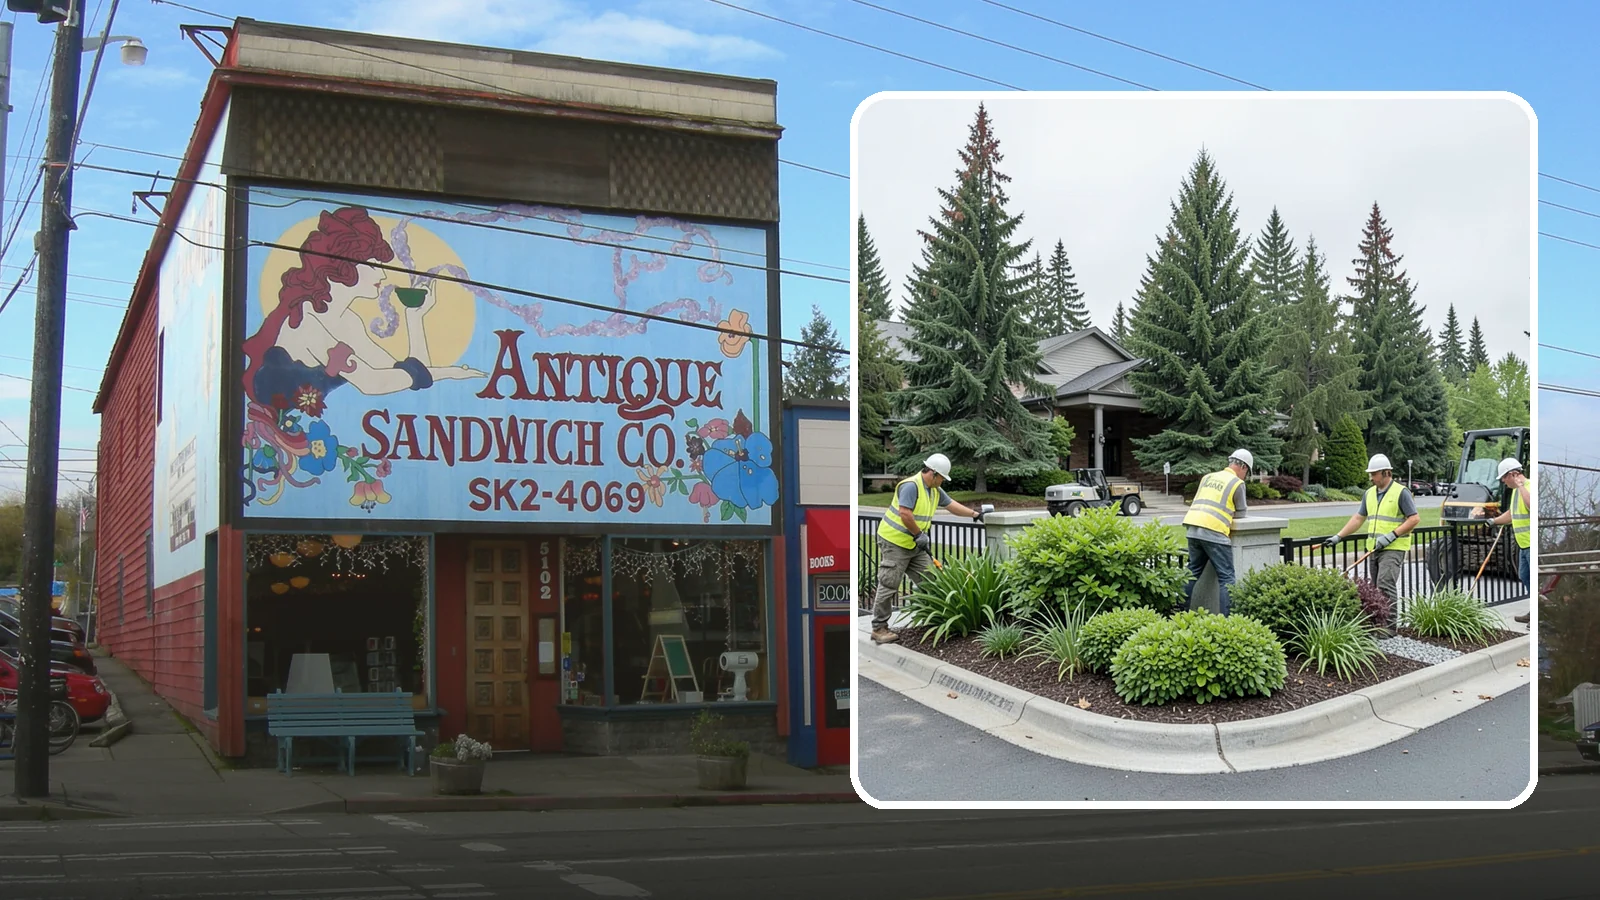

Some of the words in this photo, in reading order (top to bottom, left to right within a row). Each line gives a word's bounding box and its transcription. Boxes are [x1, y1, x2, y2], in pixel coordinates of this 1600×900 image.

[476, 329, 723, 421] ANTIQUE
[360, 408, 605, 467] SANDWICH
[616, 422, 686, 469] CO.
[467, 476, 646, 514] SK2-4069
[540, 541, 551, 600] 5102
[809, 555, 835, 569] BOOKS
